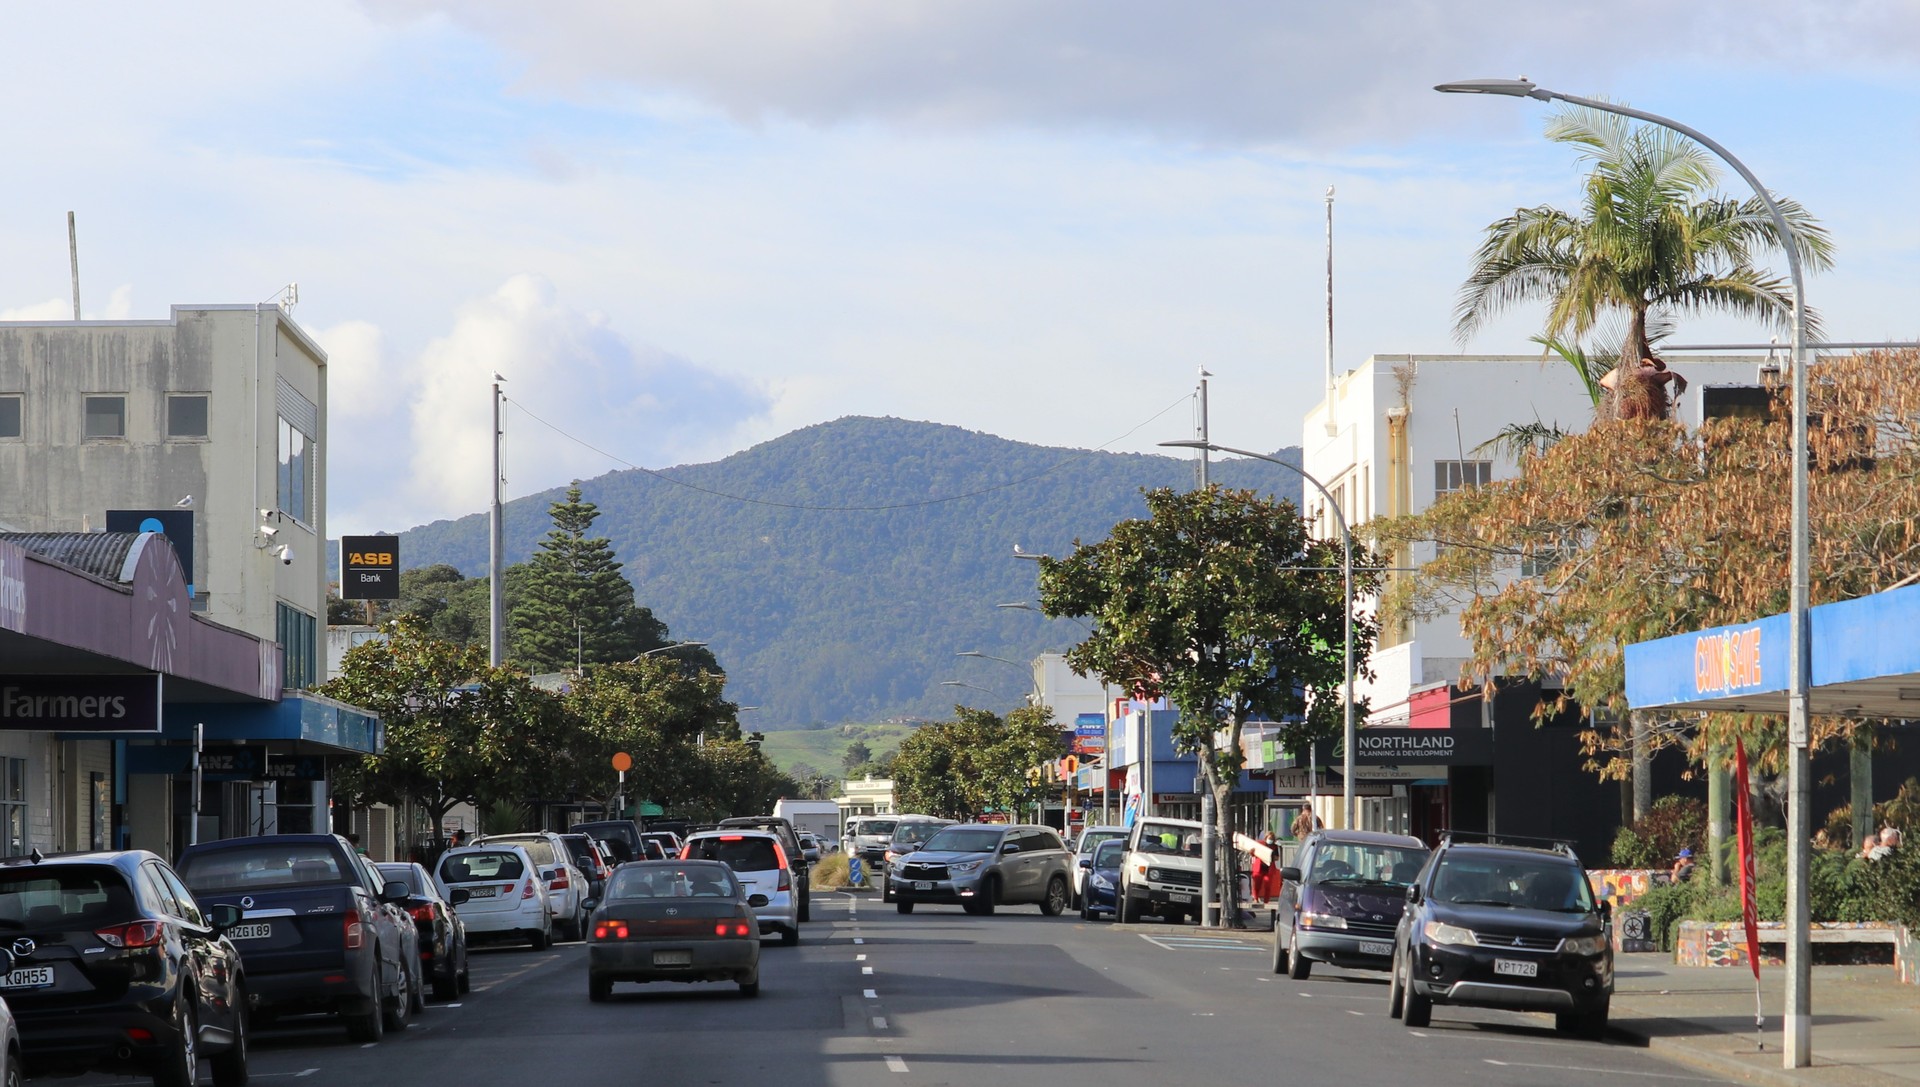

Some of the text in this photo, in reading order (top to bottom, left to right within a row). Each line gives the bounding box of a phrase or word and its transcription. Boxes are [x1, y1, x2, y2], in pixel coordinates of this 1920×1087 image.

[349, 552, 392, 565] ASB
[360, 573, 381, 582] Bank
[1695, 627, 1761, 694] COIN SAVE
[3, 686, 126, 718] Farmers
[1358, 736, 1455, 749] NORTHLAND
[1279, 774, 1296, 788] KAI
[230, 925, 270, 938] HZG189
[1497, 960, 1535, 975] KPT728
[5, 969, 48, 986] KQH55
